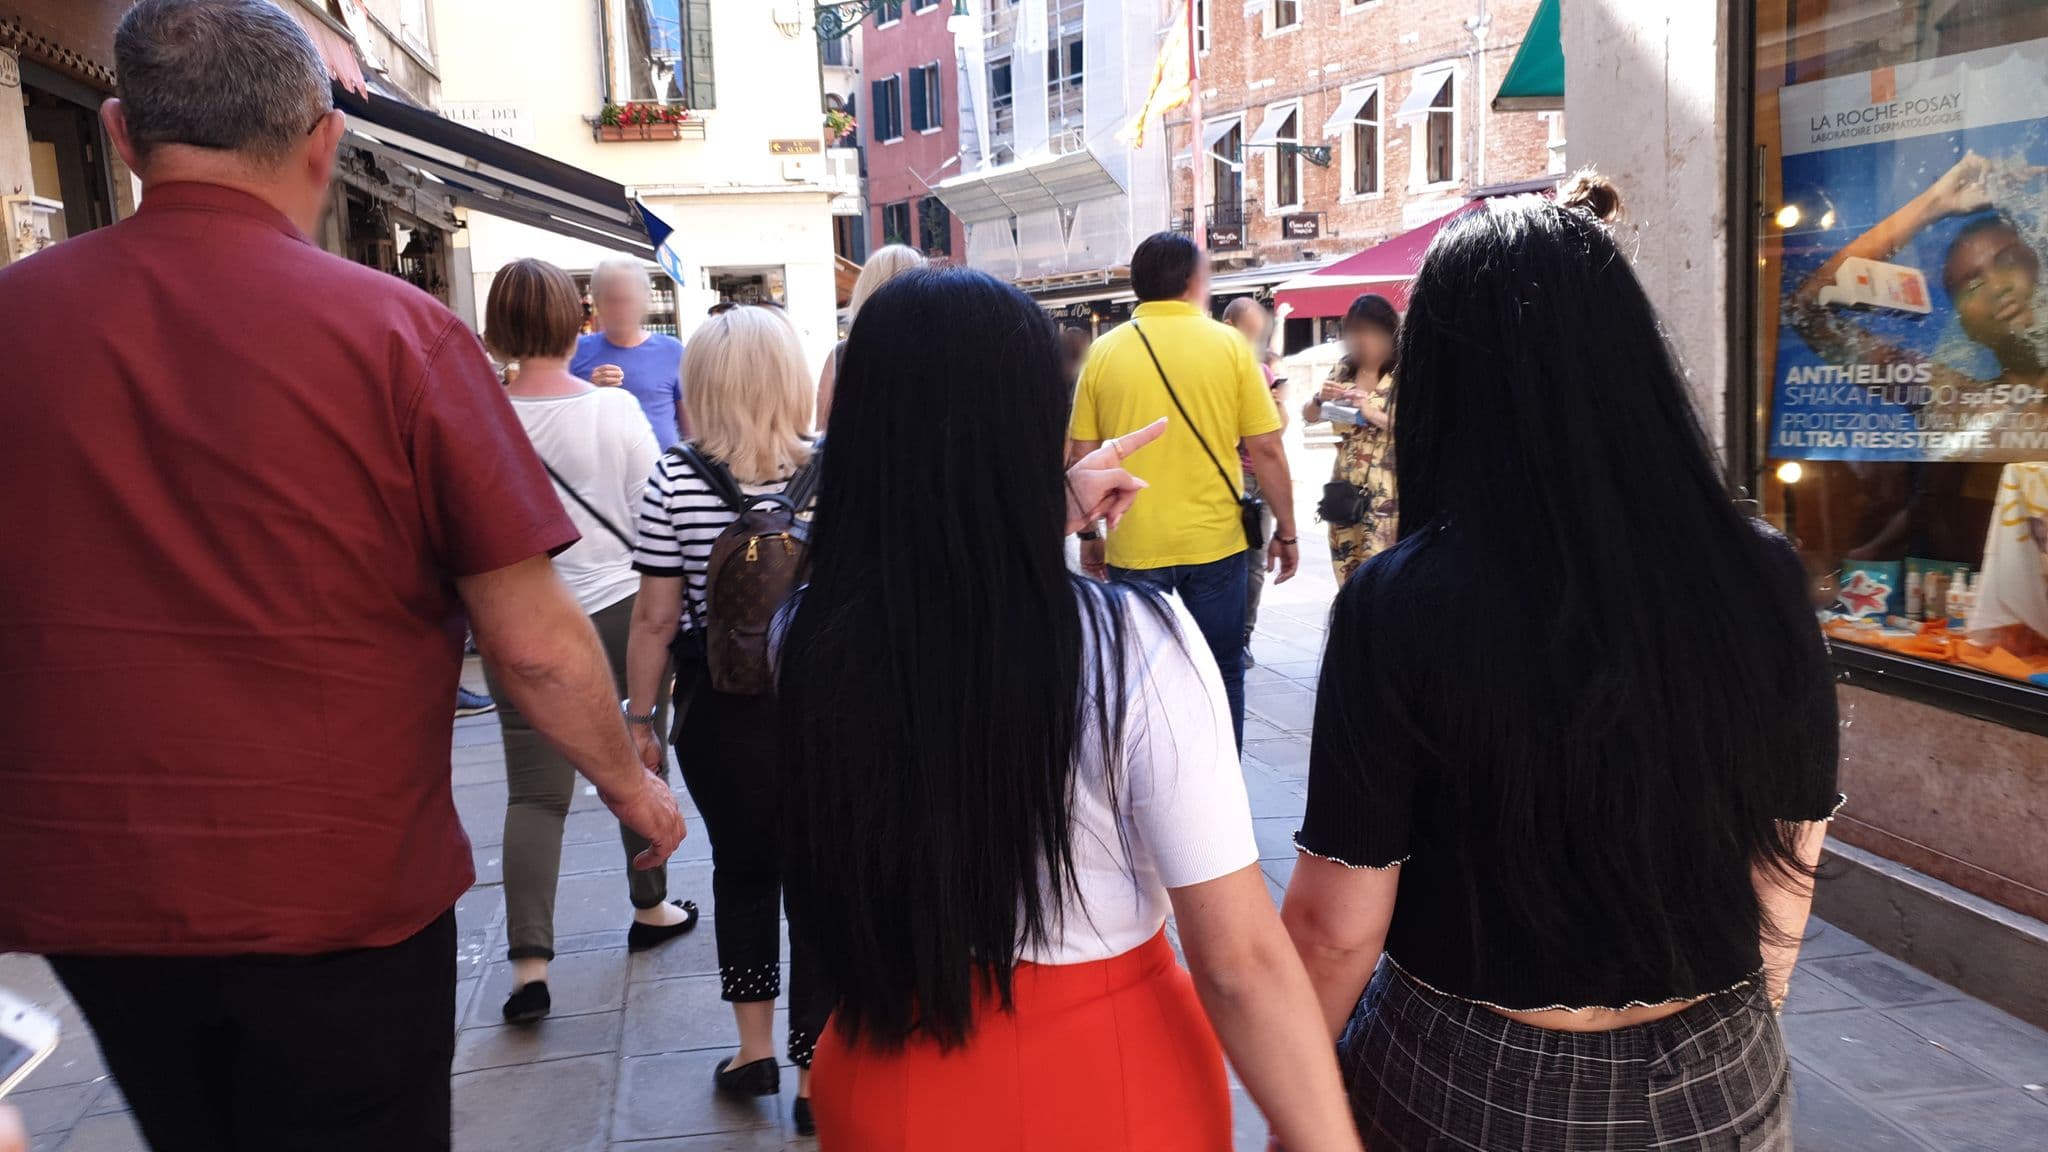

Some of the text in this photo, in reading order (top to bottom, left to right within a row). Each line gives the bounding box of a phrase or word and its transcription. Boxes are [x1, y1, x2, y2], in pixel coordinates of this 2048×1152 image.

[438, 107, 481, 121] ALLE
[1811, 92, 1961, 131] LA ROCHE-POSAY
[1810, 124, 1872, 144] LABORATOIRE
[1785, 363, 1933, 385] ANTHELIOS
[1784, 386, 1863, 406] SHAKA
[1865, 385, 1959, 406] FLUIDO
[1781, 412, 1913, 430] PROTEZIONE
[1780, 431, 1850, 448] ULTRA
